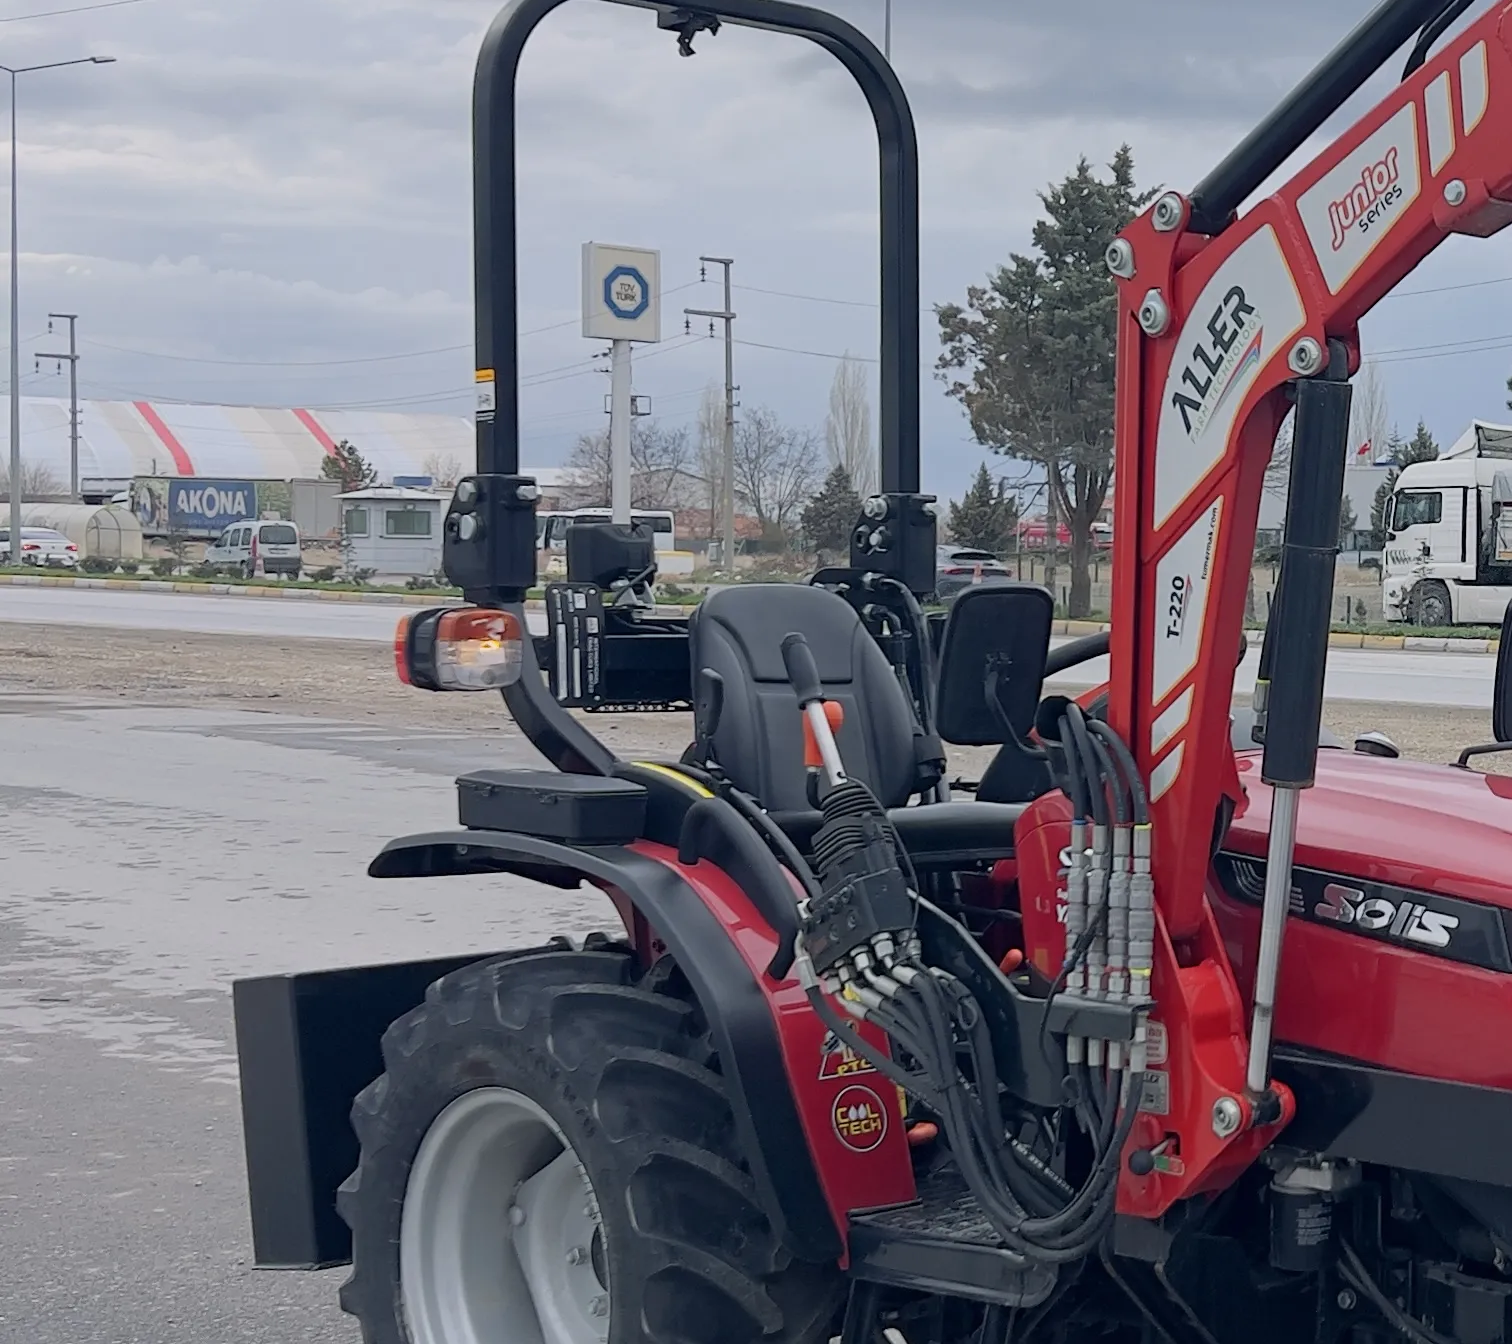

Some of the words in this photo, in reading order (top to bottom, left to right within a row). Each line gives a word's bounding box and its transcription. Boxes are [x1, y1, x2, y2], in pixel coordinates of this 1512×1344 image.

[1328, 146, 1398, 251] junior
[1358, 184, 1403, 233] series
[1172, 285, 1255, 435] ALLER
[1190, 405, 1209, 445] FARM
[1208, 309, 1263, 403] TECHNOLOGY
[176, 486, 247, 518] AKONA
[1166, 575, 1185, 639] T-220
[838, 1117, 882, 1136] TECH
